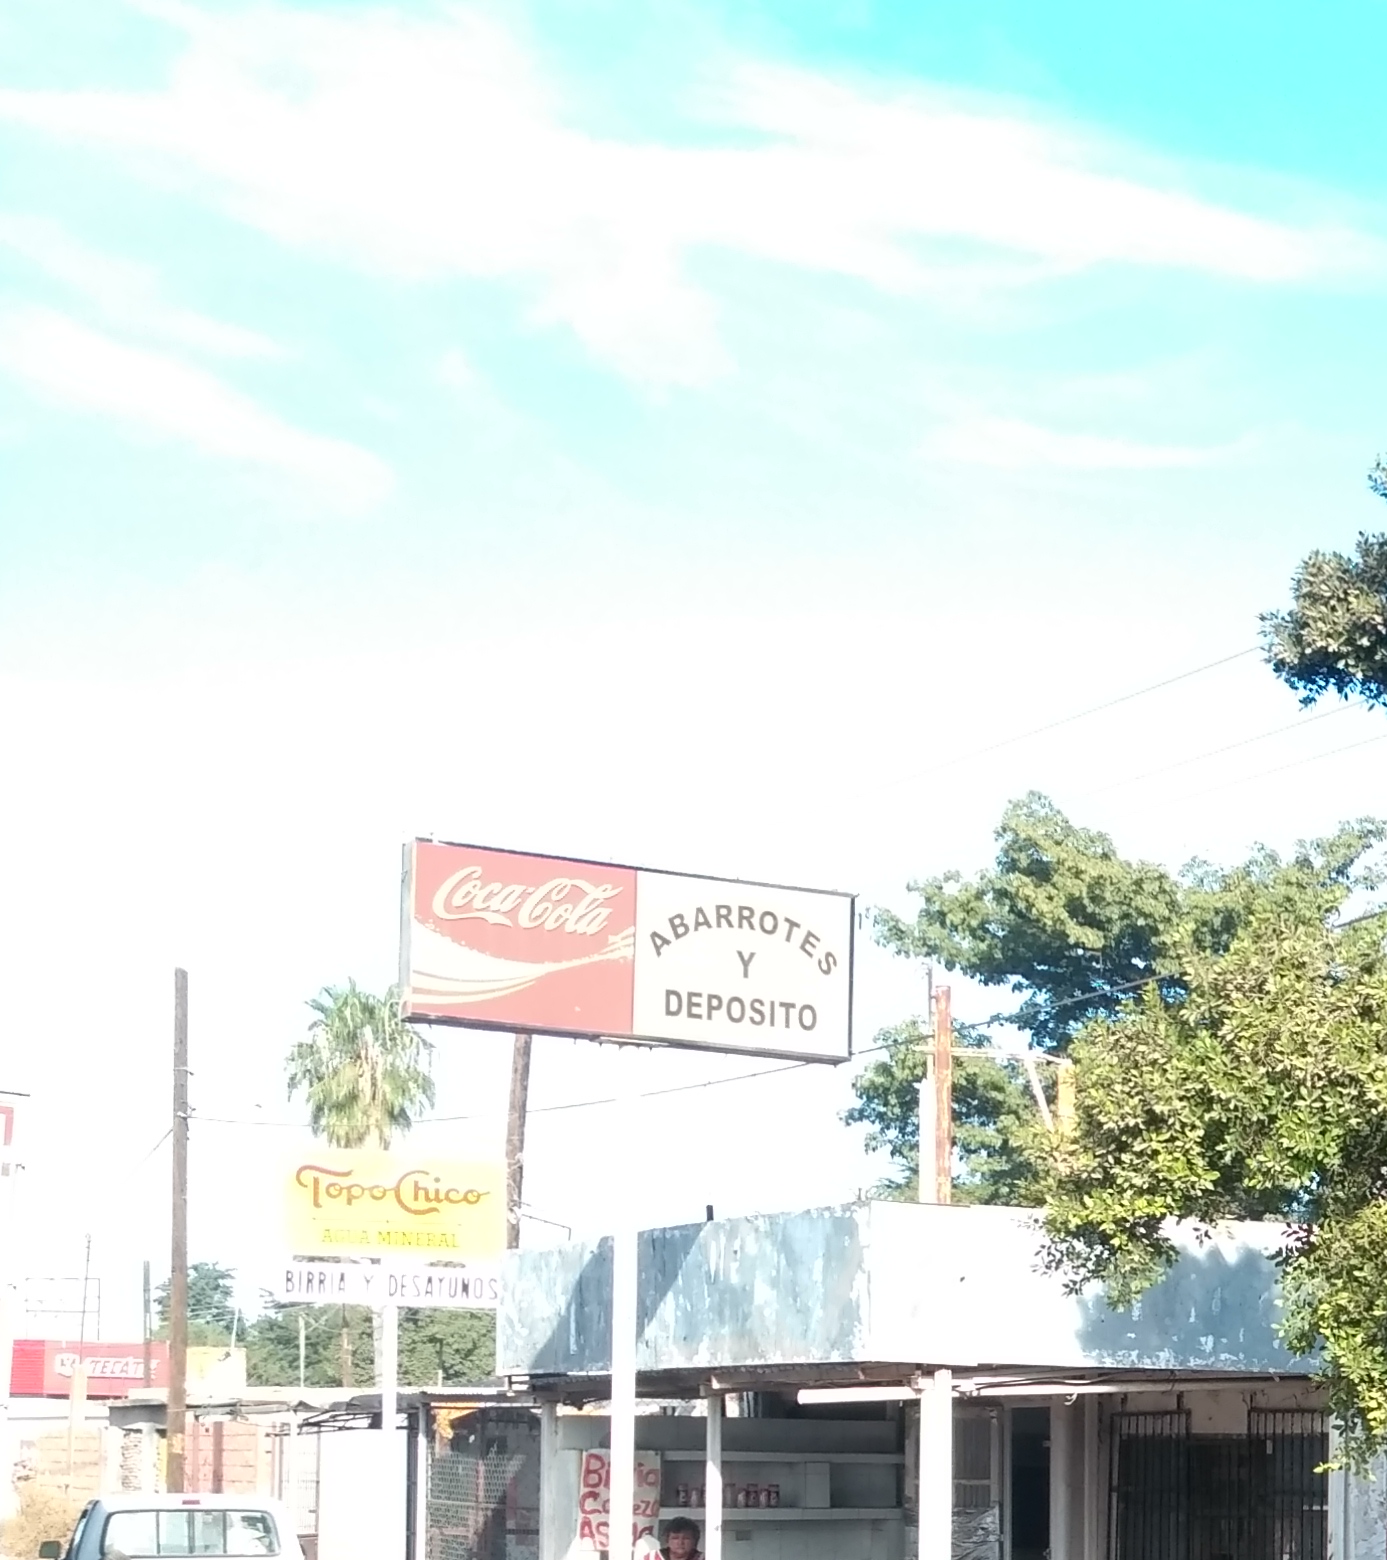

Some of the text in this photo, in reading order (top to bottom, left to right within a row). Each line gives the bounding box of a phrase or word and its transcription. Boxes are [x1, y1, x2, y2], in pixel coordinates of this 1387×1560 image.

[433, 866, 623, 936] Coca-Cola
[649, 903, 838, 977] ABARROTES
[736, 949, 757, 979] Y
[664, 988, 818, 1031] DEPOSITO
[296, 1164, 491, 1215] Topo Chico
[321, 1228, 461, 1248] AGUA MINERAL
[285, 1270, 498, 1300] BIRRIA Y DESAYUNOS
[89, 1359, 158, 1377] TECAT
[584, 1453, 660, 1488] Biia
[579, 1490, 661, 1519] Caeza
